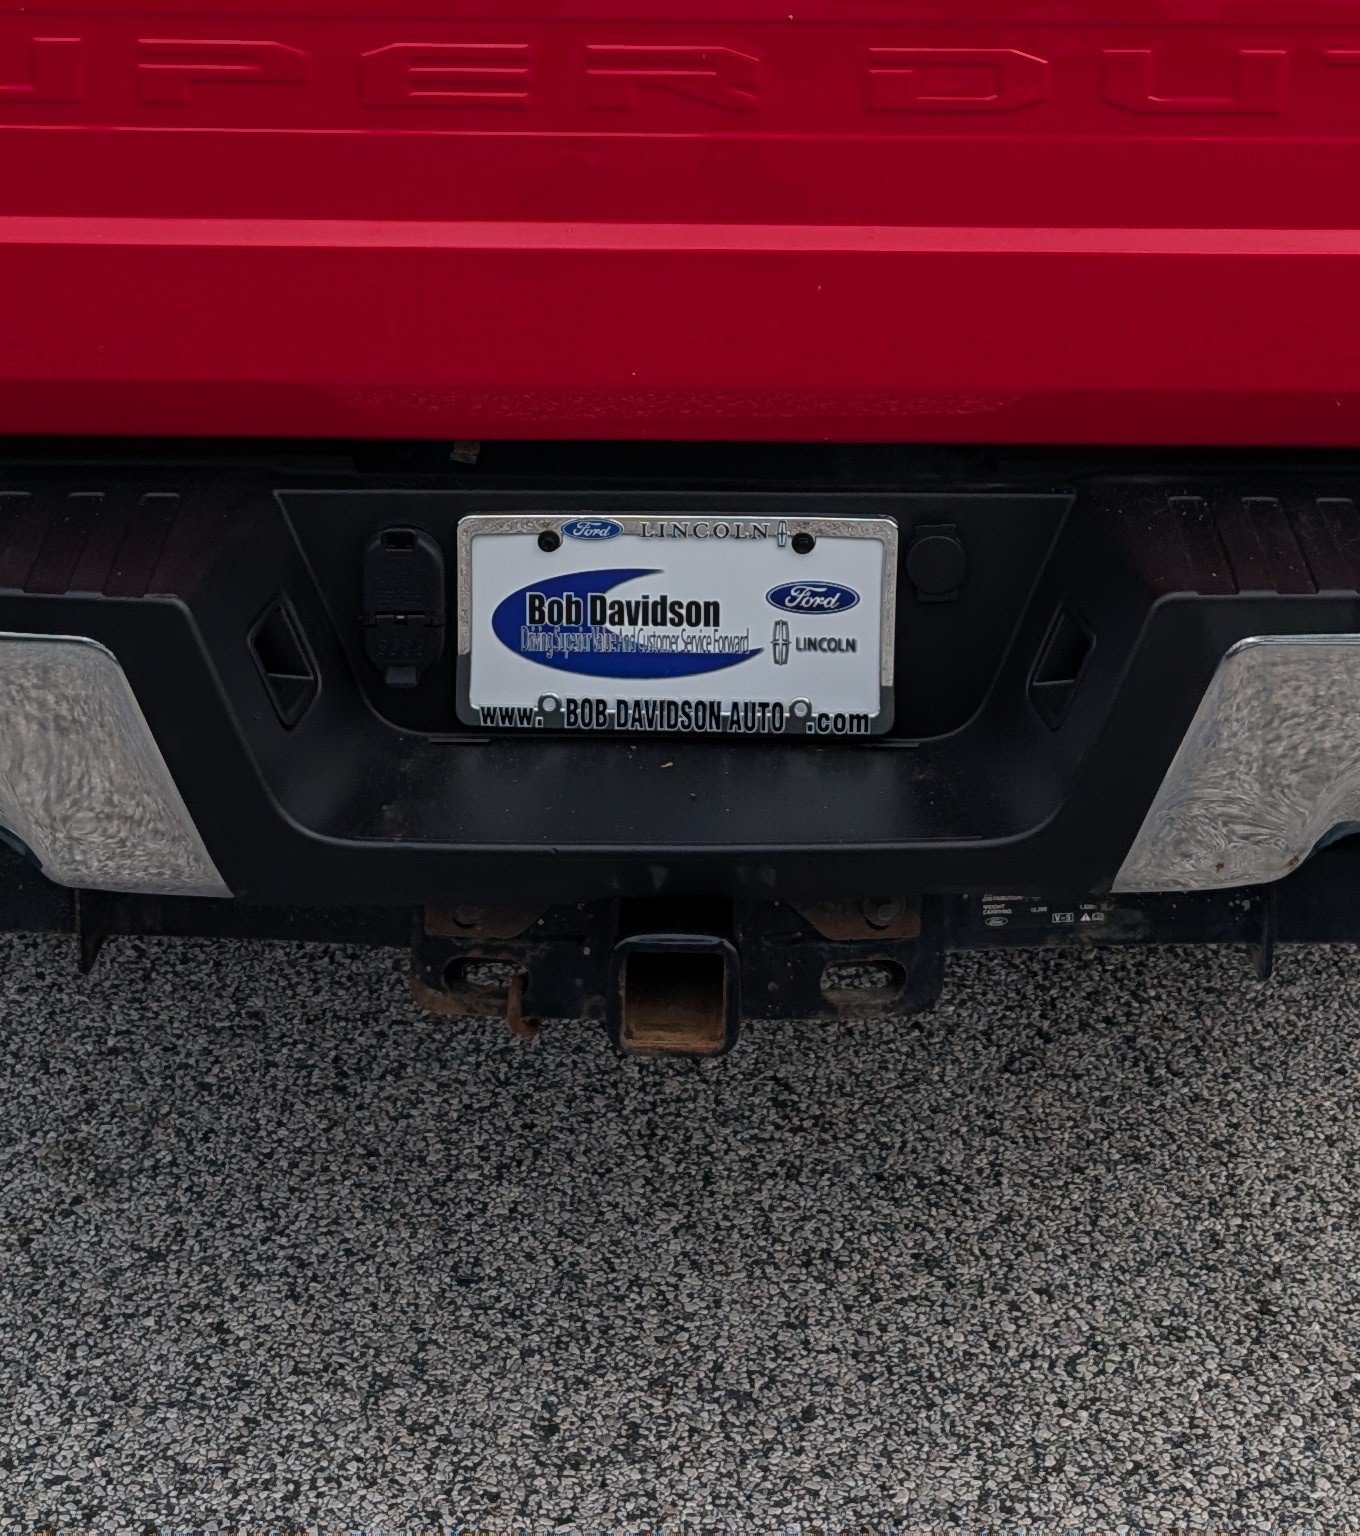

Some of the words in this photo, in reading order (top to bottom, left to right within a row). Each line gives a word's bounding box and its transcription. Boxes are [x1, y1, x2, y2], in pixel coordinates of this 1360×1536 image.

[572, 521, 612, 538] Ford
[640, 521, 770, 539] LINCOLN
[526, 592, 583, 627] Bob
[587, 594, 721, 628] Davidson
[784, 586, 841, 609] Ford
[520, 625, 552, 659] Driving
[552, 625, 590, 659] Superior
[591, 627, 616, 652] Value
[617, 627, 637, 653] And
[638, 627, 680, 653] Customer
[681, 628, 712, 653] Service
[713, 628, 750, 654] Forward
[795, 636, 857, 653] LINCOLN
[565, 697, 608, 729] BOB
[615, 697, 723, 732] DAVIDSON
[726, 699, 785, 733] AUTO
